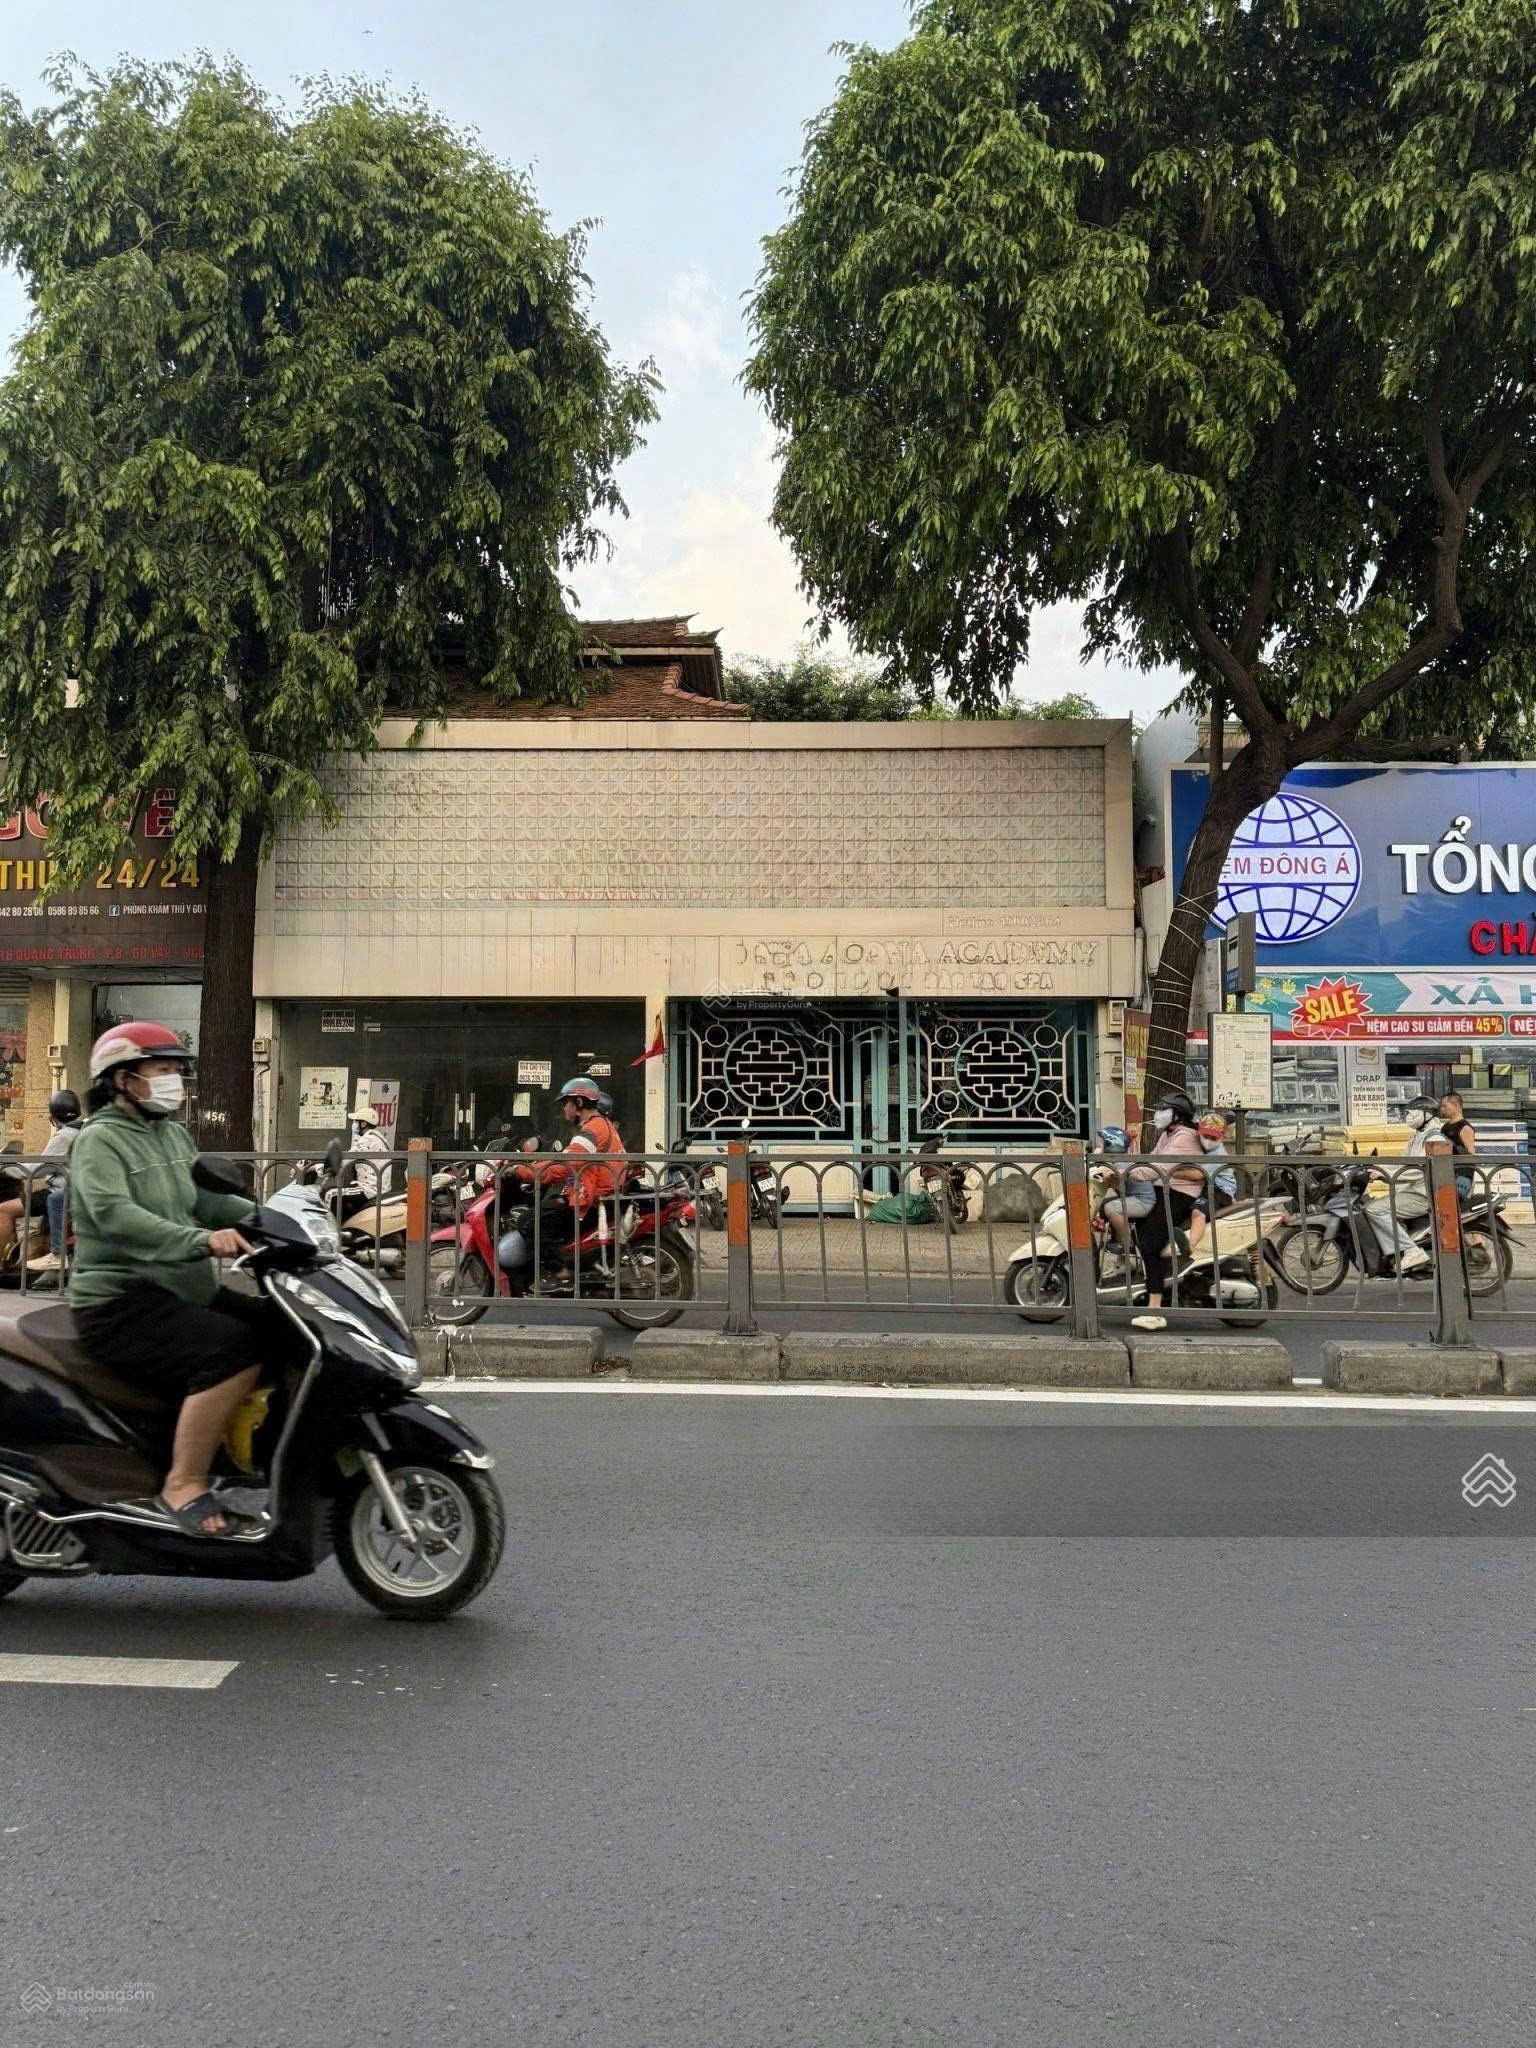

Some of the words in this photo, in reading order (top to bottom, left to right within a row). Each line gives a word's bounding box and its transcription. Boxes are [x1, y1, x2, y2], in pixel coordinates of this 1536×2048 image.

[1259, 852, 1327, 875] ĐÔNG
[1335, 852, 1350, 875] Á
[0, 907, 11, 917] 42
[1470, 911, 1536, 955] CH
[937, 941, 1099, 966] ACADEMY
[1014, 971, 1054, 990] SPA
[1430, 976, 1504, 1005] XẢ
[1305, 989, 1359, 1025] SALE
[1366, 1018, 1389, 1036] NỆM
[1391, 1020, 1410, 1033] CAO
[1411, 1020, 1426, 1033] SU
[1427, 1017, 1451, 1033] GIẢM
[1454, 1016, 1474, 1033] ĐẾN
[1475, 1017, 1503, 1033] 45%
[1514, 1018, 1536, 1036] NỆ
[1355, 1075, 1381, 1083] DRAP
